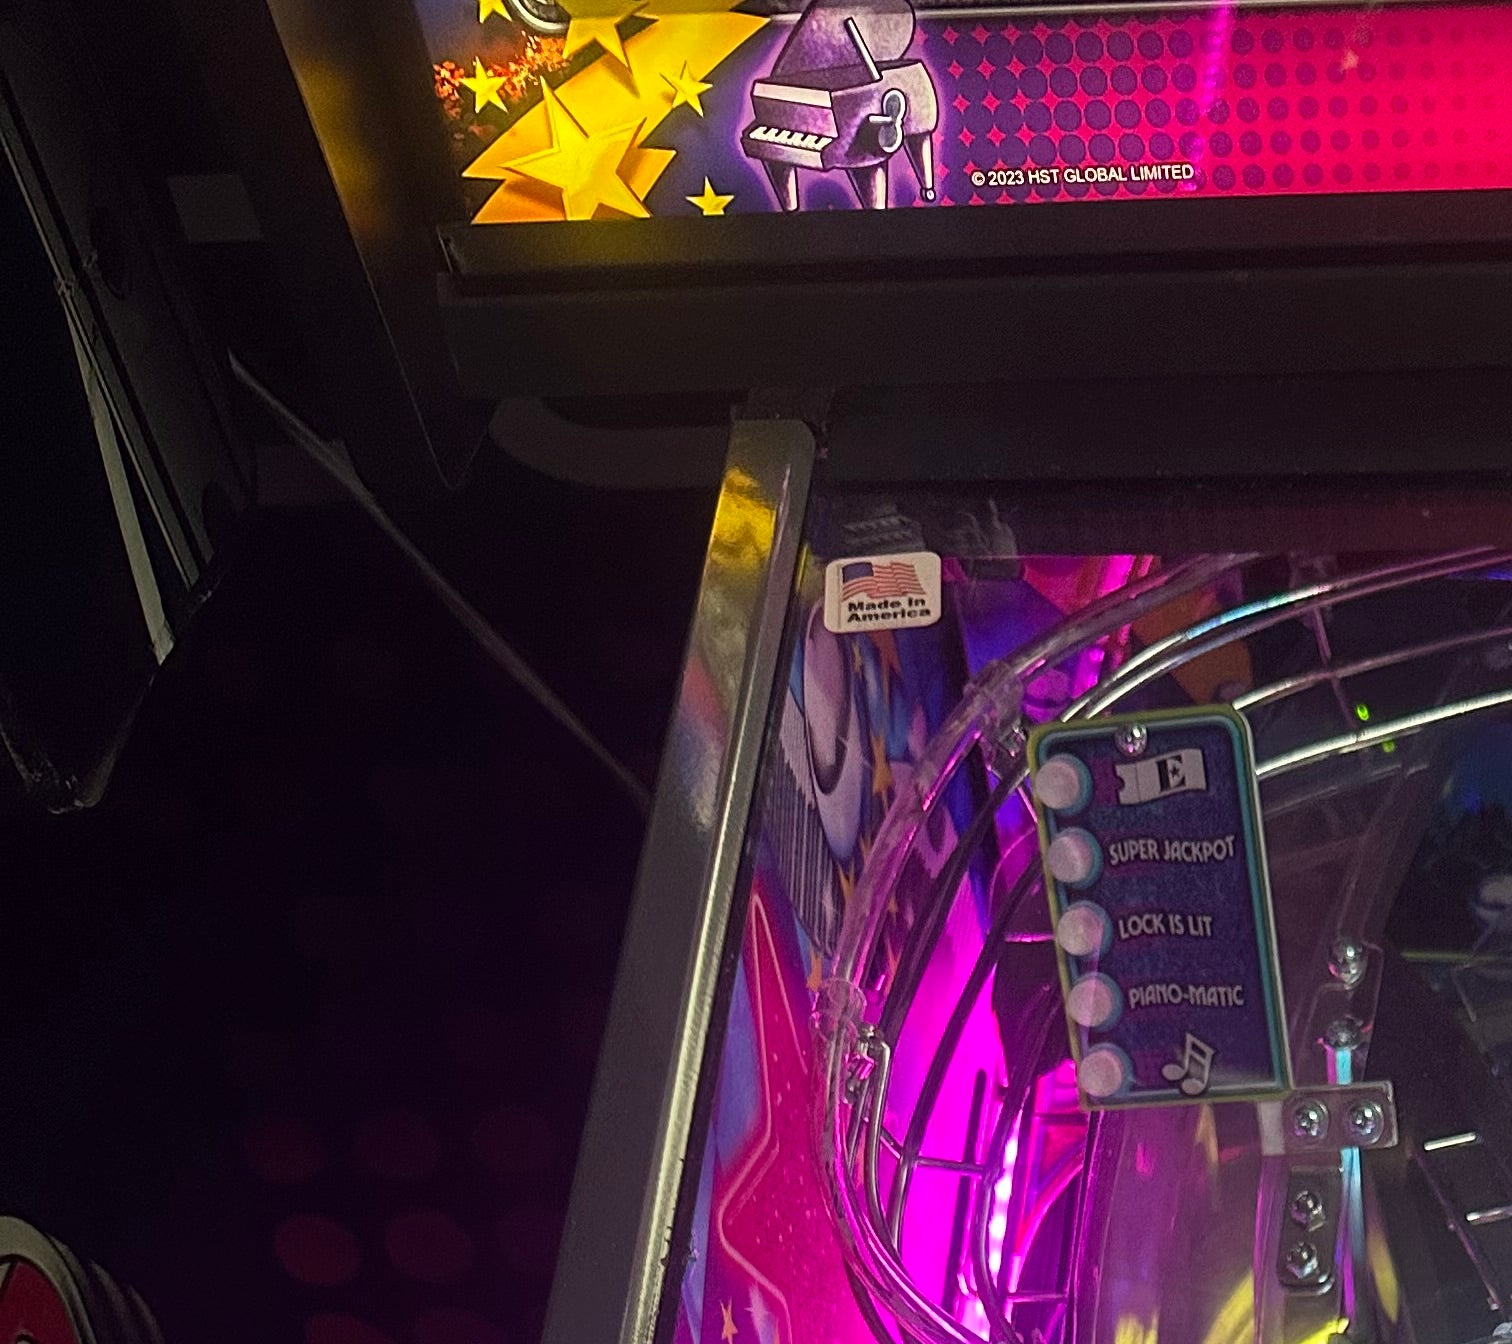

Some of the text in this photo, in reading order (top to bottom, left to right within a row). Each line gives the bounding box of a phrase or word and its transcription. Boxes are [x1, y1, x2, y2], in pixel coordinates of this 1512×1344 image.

[988, 170, 1024, 186] 2023
[1028, 168, 1059, 184] HST
[1063, 166, 1128, 183] GLOBAL
[1130, 164, 1194, 181] LIMITED
[848, 599, 902, 612] Made
[848, 608, 931, 623] America
[1156, 756, 1187, 793] E
[1109, 835, 1236, 866] SUPER JACKPOT
[1118, 914, 1213, 940] LOCK IS LIT
[1128, 984, 1245, 1010] PIANO-MATIC
